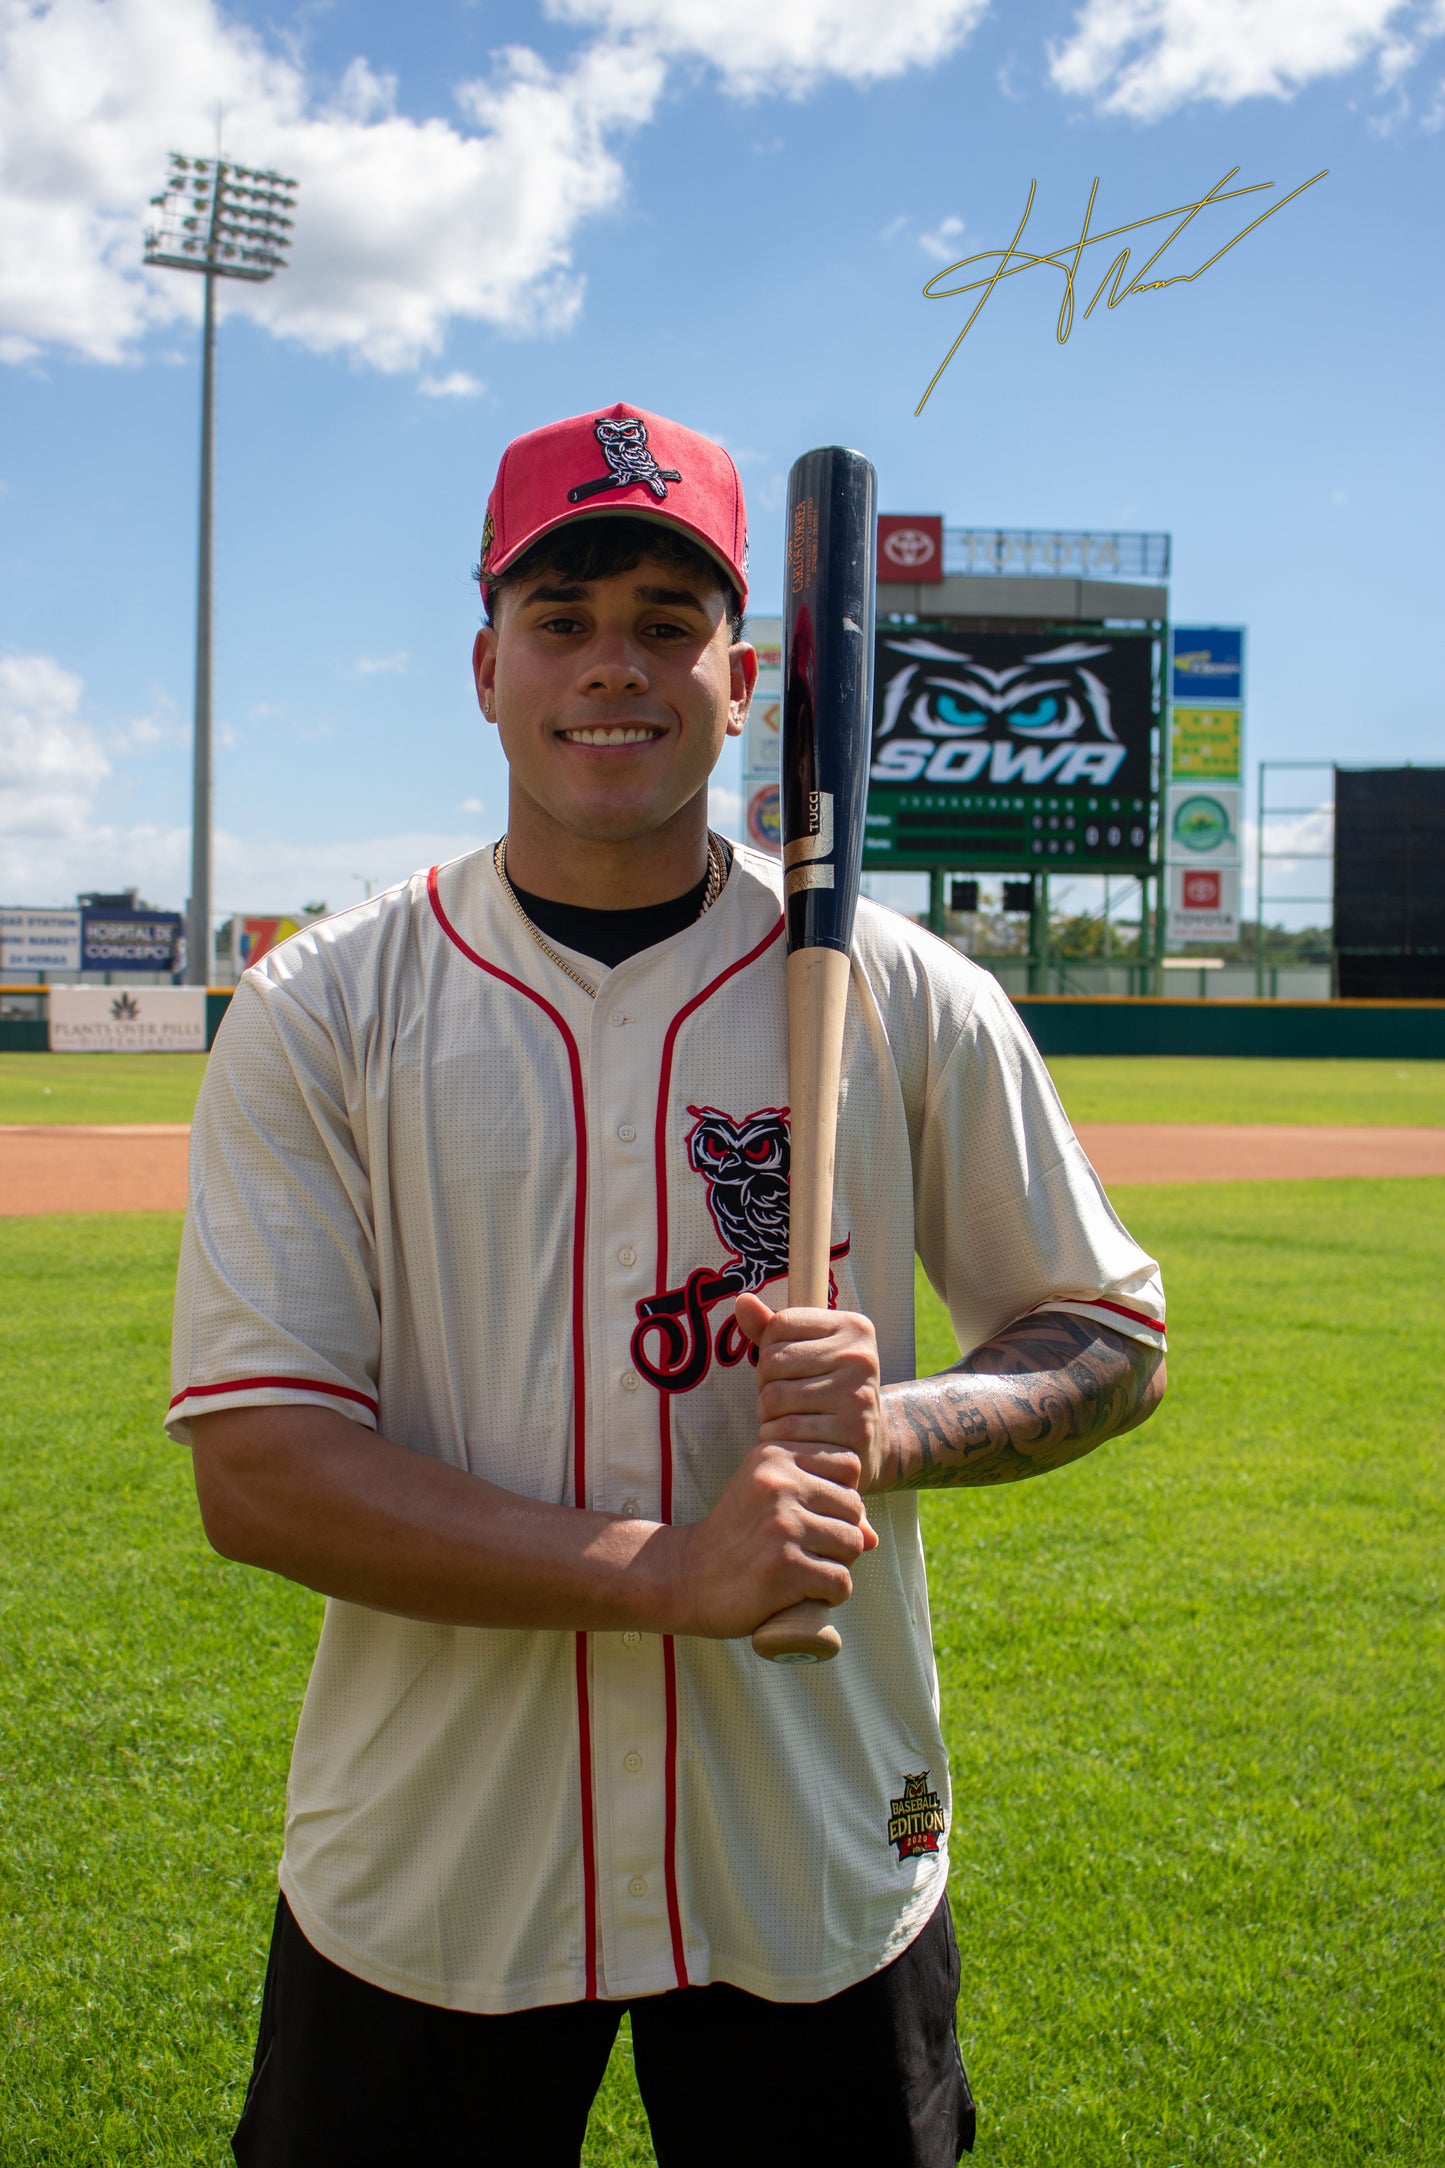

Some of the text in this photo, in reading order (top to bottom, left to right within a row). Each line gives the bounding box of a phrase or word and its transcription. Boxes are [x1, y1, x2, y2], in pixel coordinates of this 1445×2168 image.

[793, 500, 806, 593] CARLOS CORREA
[960, 535, 1122, 568] TOYOTA
[870, 738, 1127, 786] SOWA
[809, 791, 819, 832] TUCCI
[1085, 826, 1144, 847] 0 0 0
[1174, 913, 1233, 925] TOYOTA
[86, 924, 172, 941] HOSPITAL DE
[54, 1023, 200, 1036] PLANTS OVER PILLS
[891, 1794, 939, 1816] BASEBALL
[889, 1810, 944, 1842] EDITION
[907, 1834, 928, 1847] 2020
